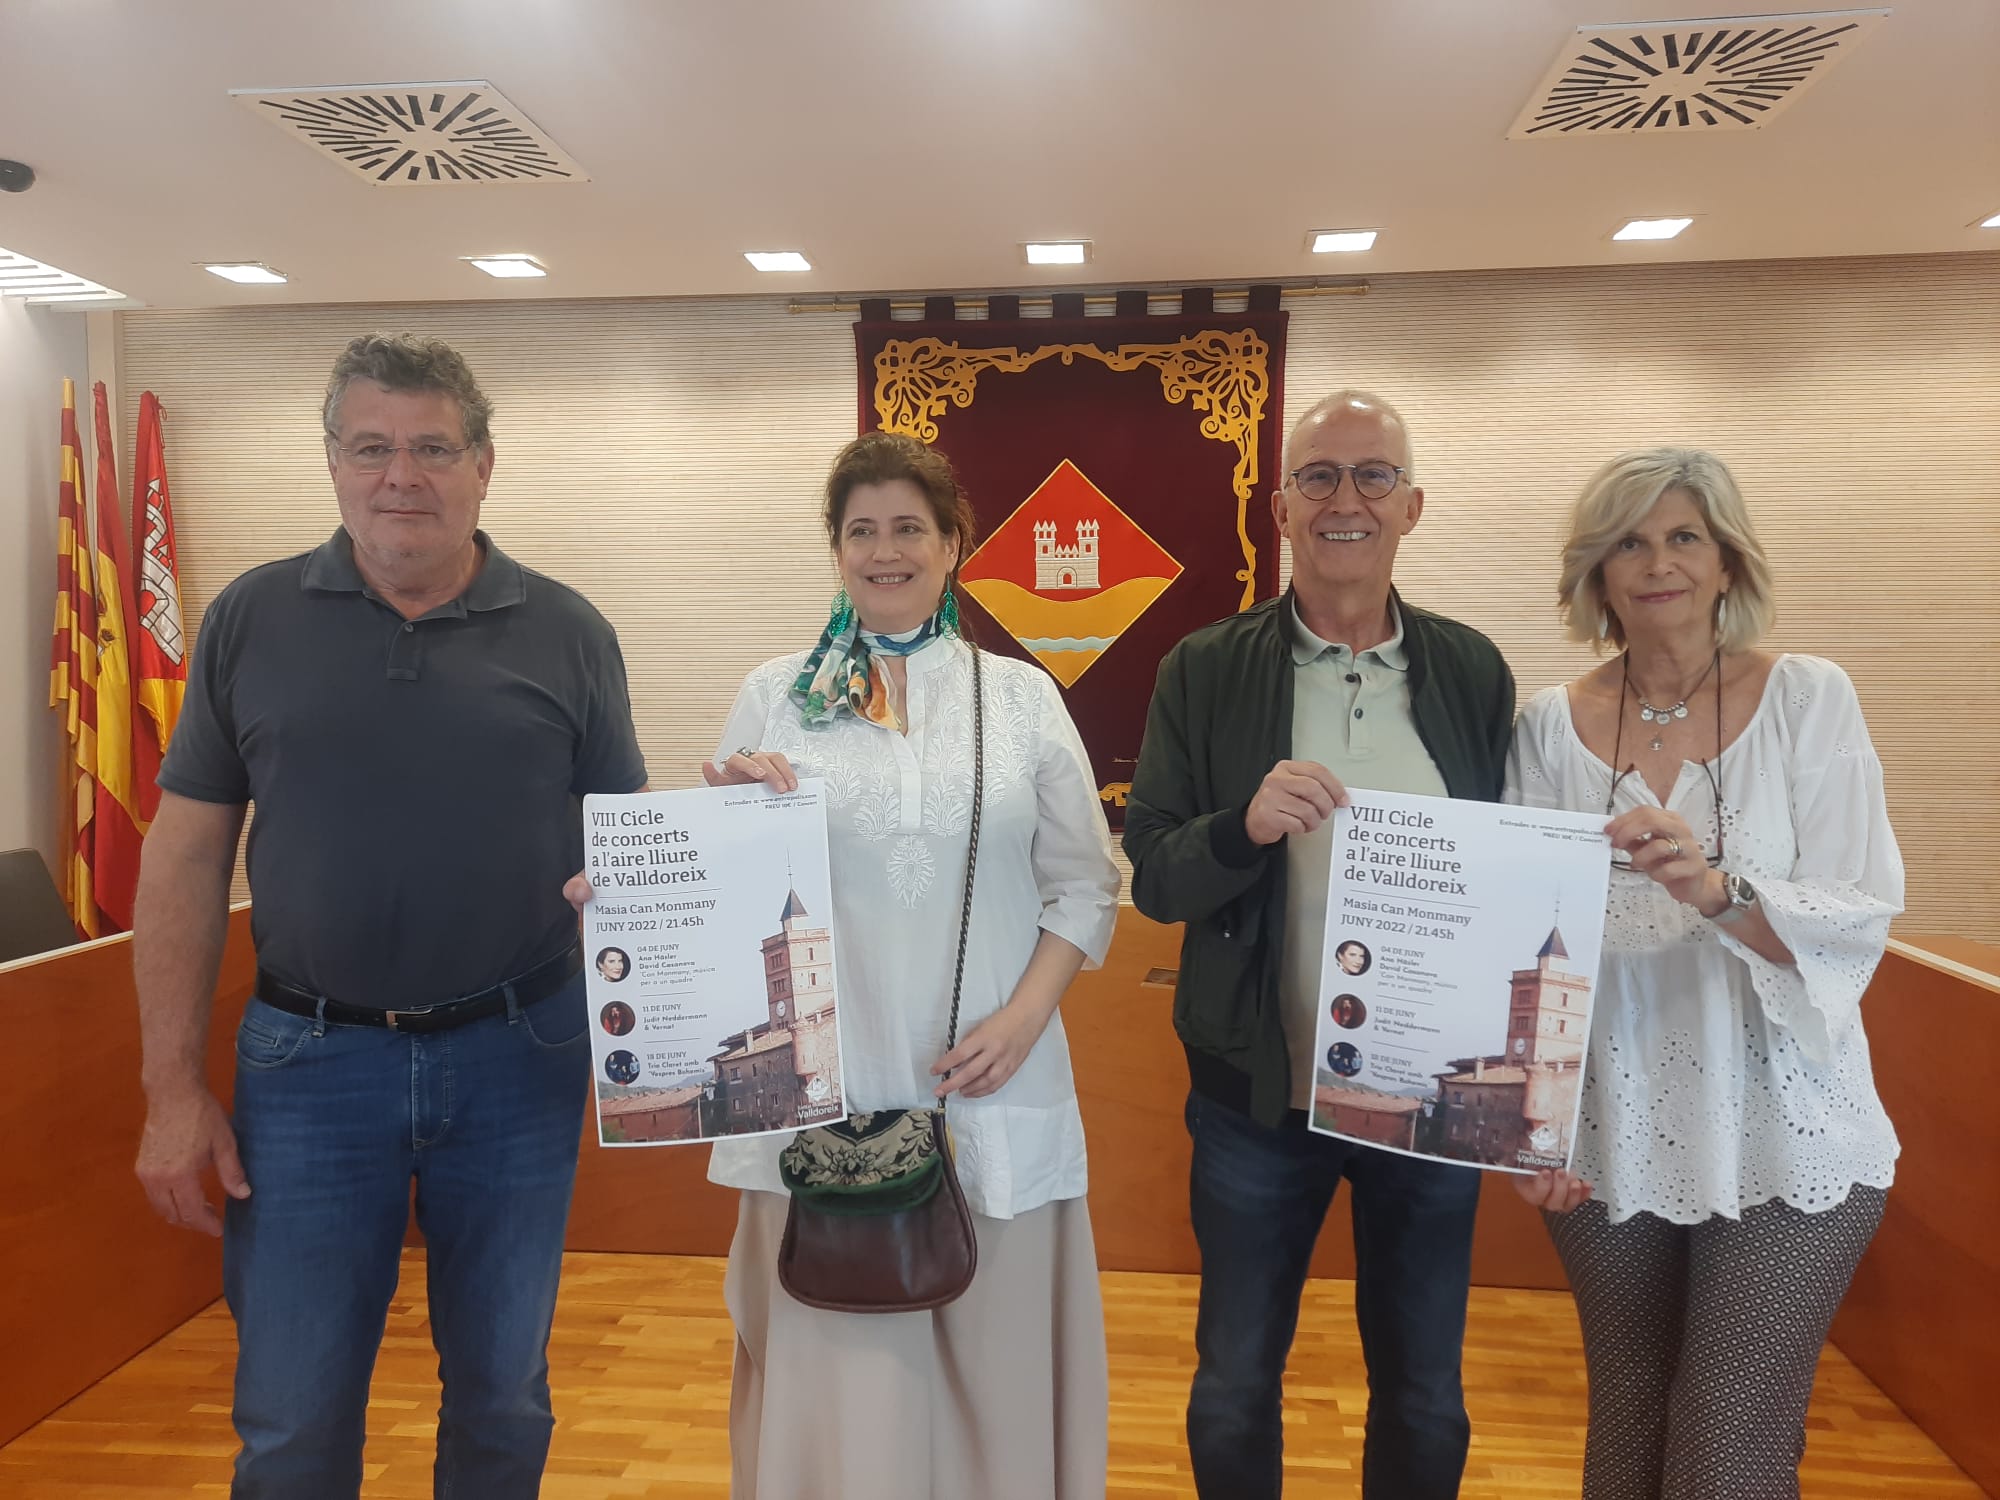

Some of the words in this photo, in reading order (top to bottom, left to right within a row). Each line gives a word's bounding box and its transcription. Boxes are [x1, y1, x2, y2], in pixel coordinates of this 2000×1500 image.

[591, 812, 616, 827] VIII
[620, 810, 664, 826] Cicle
[1350, 806, 1383, 822] VIII
[1389, 810, 1434, 829] Cicle
[592, 832, 607, 847] de
[611, 828, 689, 846] concerts
[1348, 826, 1370, 842] de
[1374, 830, 1456, 852] concerts
[592, 856, 599, 867] a
[650, 848, 698, 865] lliure
[1346, 849, 1356, 860] a
[1410, 852, 1461, 873] lliure
[592, 873, 610, 887] de
[614, 867, 707, 887] Valldoreix
[1344, 866, 1366, 882] de
[1371, 870, 1467, 896] Valldoreix
[595, 903, 627, 915] Masia
[630, 903, 652, 914] Can
[655, 899, 716, 913] Monmany
[1344, 898, 1378, 912] Masia
[1380, 903, 1404, 916] Can
[1408, 907, 1471, 926] Monmany
[596, 922, 624, 933] JUNY
[627, 920, 657, 931] 2022
[659, 918, 663, 930] /
[1340, 914, 1373, 928] JUNY
[1376, 920, 1406, 934] 2022
[1408, 924, 1413, 936] /
[660, 944, 679, 952] JUNY
[1404, 950, 1425, 958] JUNY
[662, 1004, 681, 1012] JUNY
[1395, 1009, 1416, 1018] JUNY
[1392, 1057, 1413, 1066] JUNY
[798, 1104, 838, 1118] Valldoreix
[1517, 1154, 1563, 1167] Valldoreix
